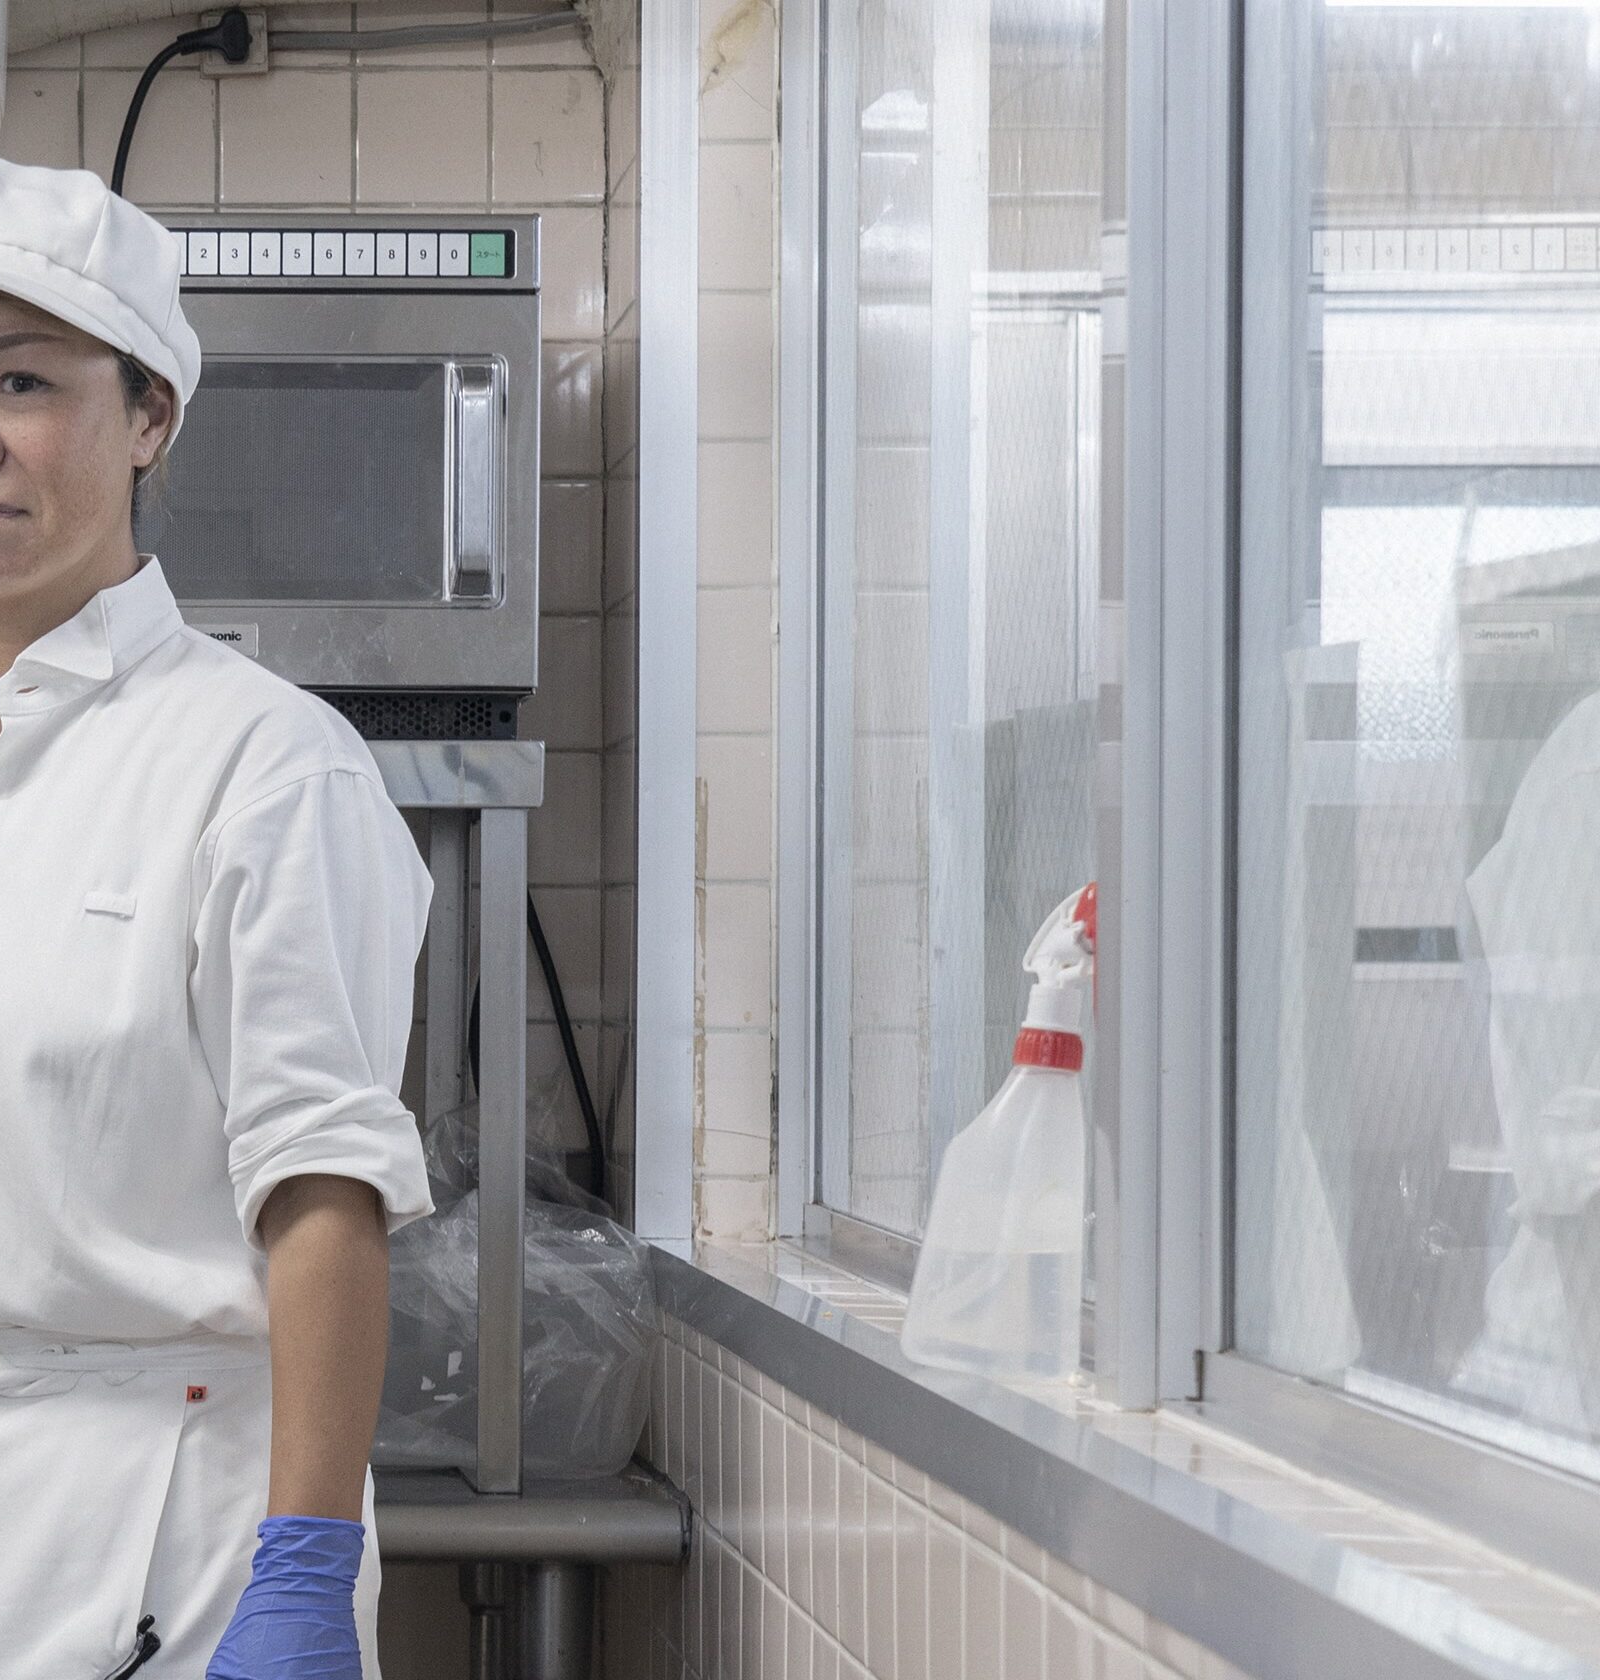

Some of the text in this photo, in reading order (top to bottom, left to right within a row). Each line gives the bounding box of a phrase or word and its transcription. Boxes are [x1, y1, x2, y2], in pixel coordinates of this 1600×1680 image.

[200, 248, 458, 260] 2 3 4 5 6 7 8 9 0
